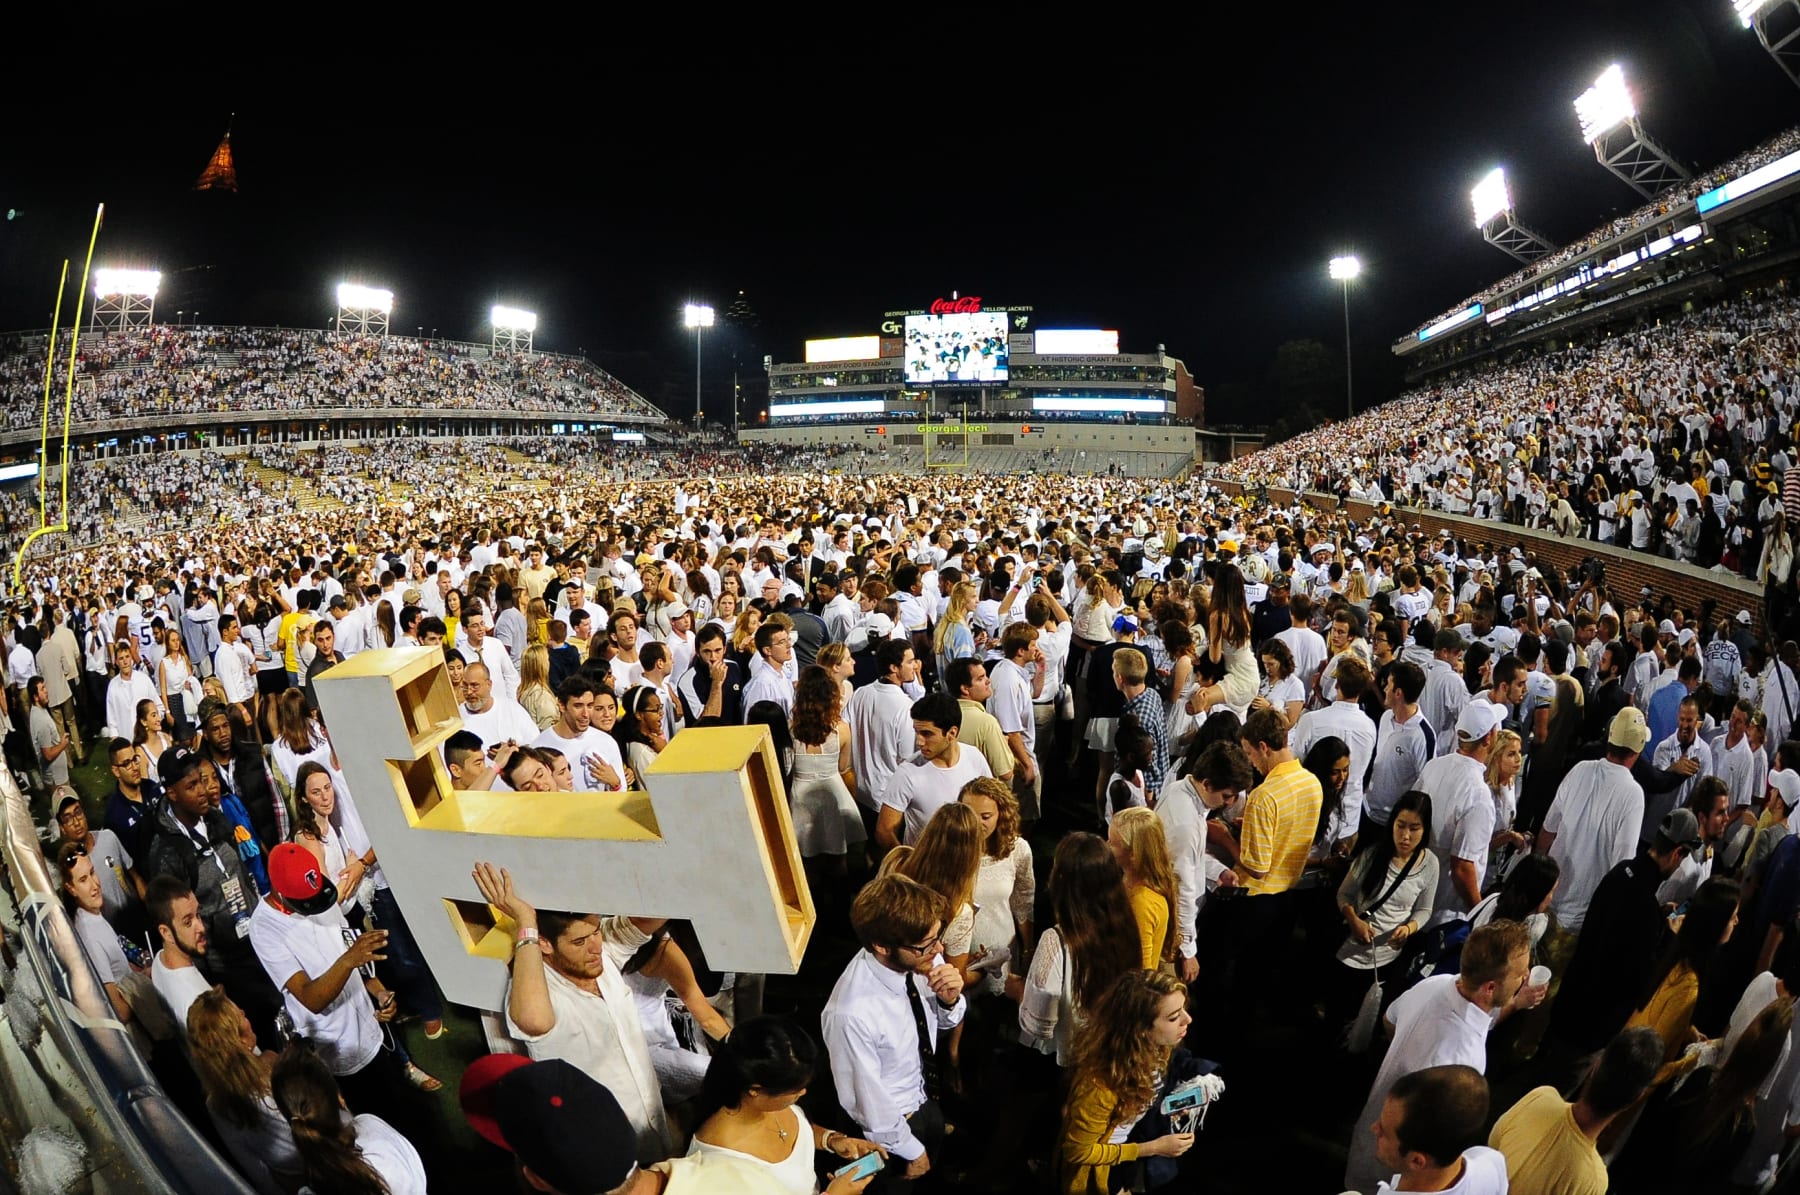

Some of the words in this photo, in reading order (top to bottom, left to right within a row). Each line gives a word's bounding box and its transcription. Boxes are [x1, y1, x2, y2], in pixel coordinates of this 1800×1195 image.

[930, 297, 982, 314] Coca-Cola
[881, 321, 902, 335] GT
[917, 424, 960, 434] Georgia
